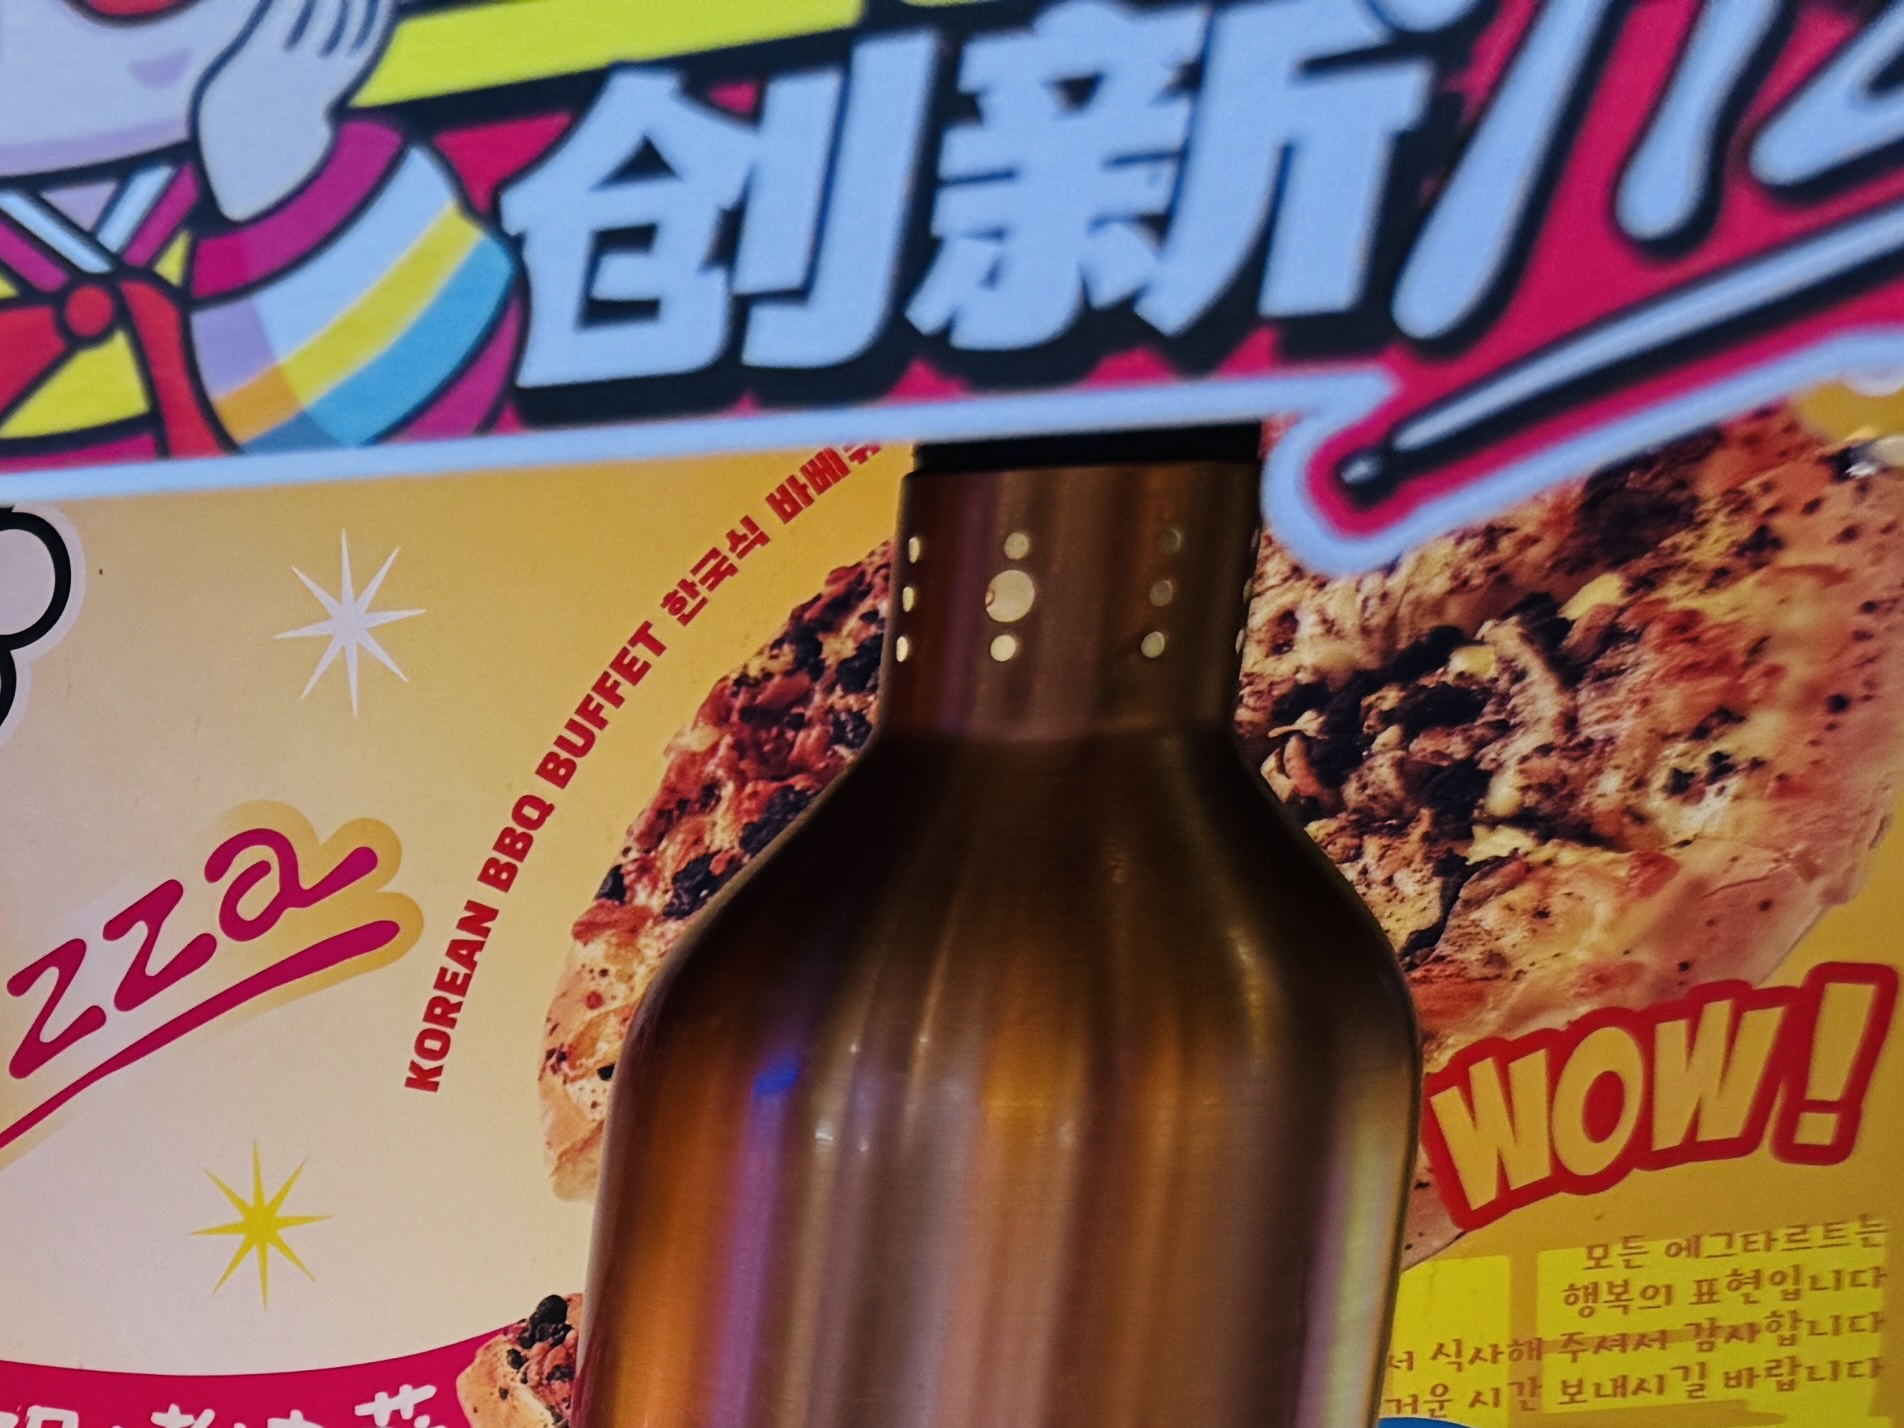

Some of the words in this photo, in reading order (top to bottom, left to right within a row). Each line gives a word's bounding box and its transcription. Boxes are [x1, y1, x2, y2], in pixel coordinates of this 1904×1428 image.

[497, 28, 1437, 388] 创新
[404, 899, 501, 1092] KOREAN
[477, 794, 555, 893] BBQ
[535, 620, 668, 790] BUFFET
[660, 514, 771, 627] 한국식
[1429, 980, 1878, 1213] WOW!
[1583, 1234, 1650, 1272] 모든
[1561, 1276, 1676, 1319] 행복의
[1690, 1264, 1890, 1306] 표현입니다
[1430, 1337, 1545, 1370] 식사해
[1557, 1327, 1671, 1360] 주셔서
[1683, 1308, 1886, 1354] 감사합니다
[1467, 1375, 1543, 1413] 시간
[1557, 1361, 1708, 1408] 보내시길
[1721, 1353, 1885, 1394] 바랍니다
